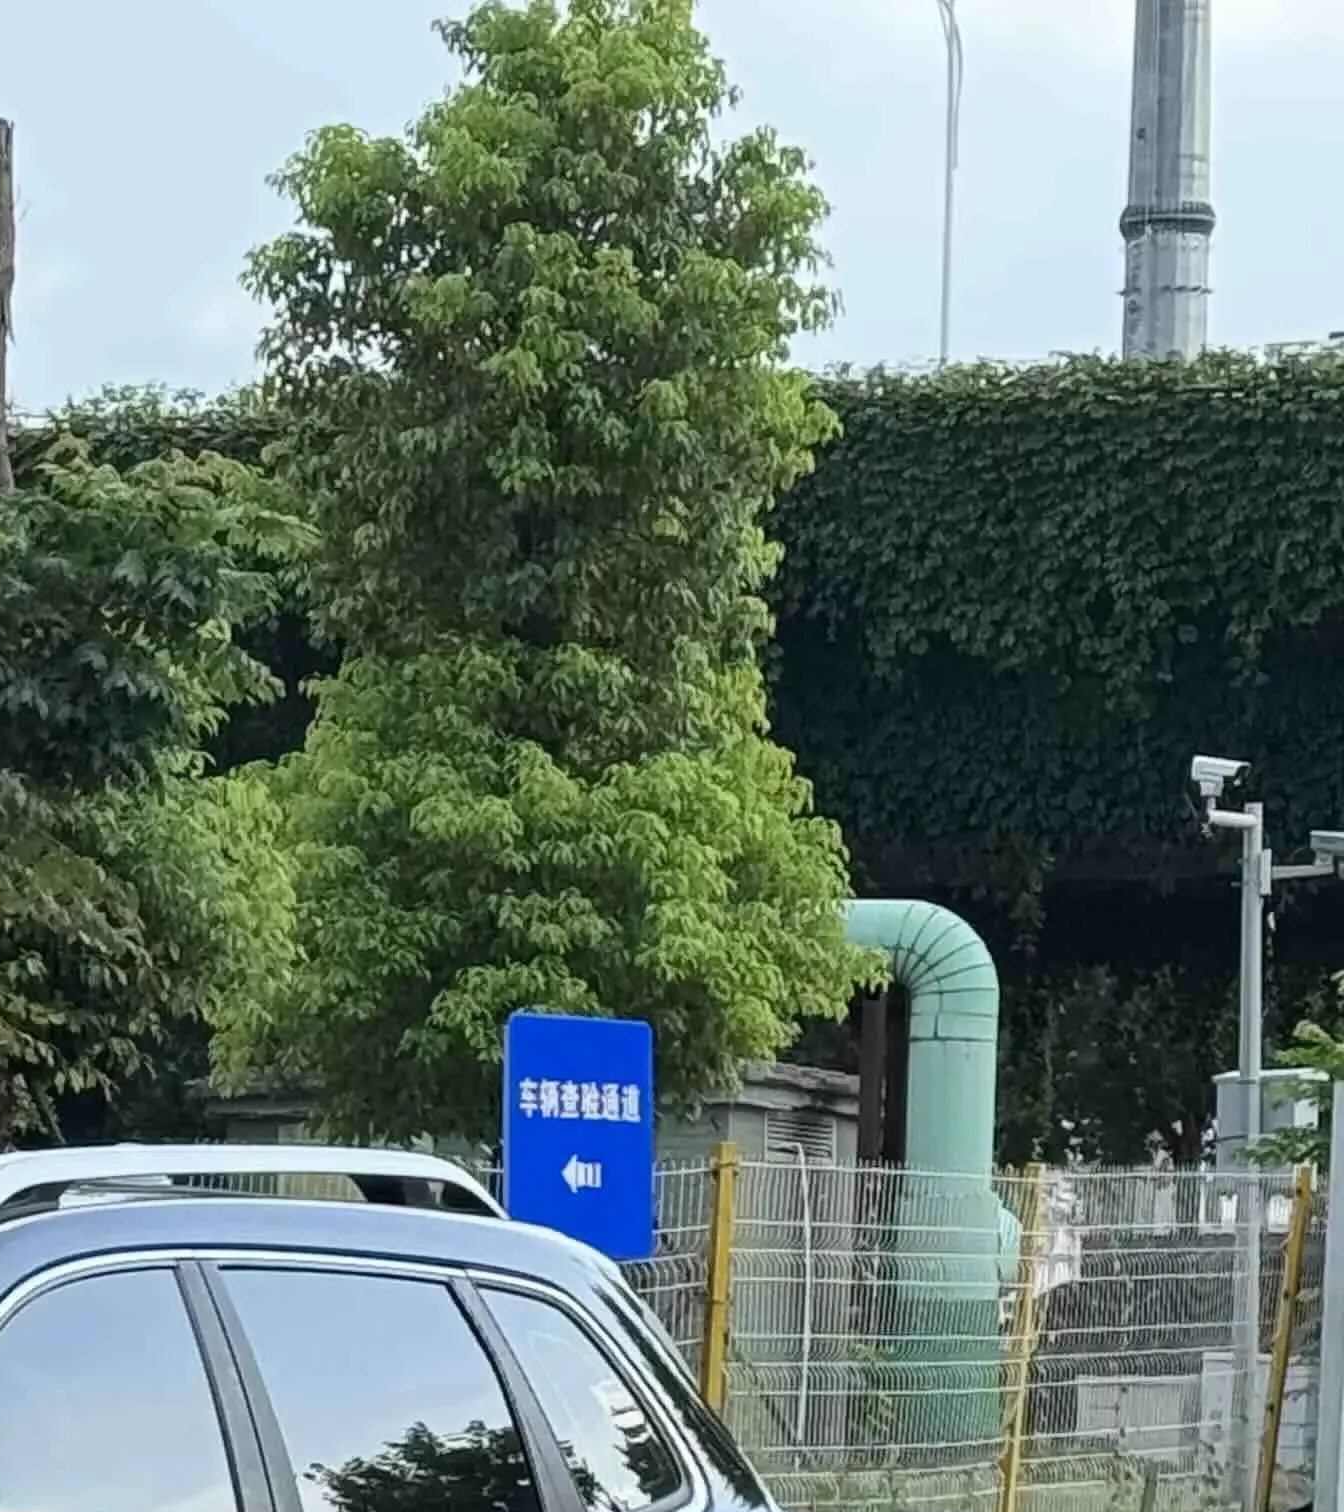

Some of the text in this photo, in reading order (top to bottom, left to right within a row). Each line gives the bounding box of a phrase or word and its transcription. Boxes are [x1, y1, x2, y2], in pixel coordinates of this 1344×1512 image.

[519, 1077, 641, 1123] 车辆查验通道
